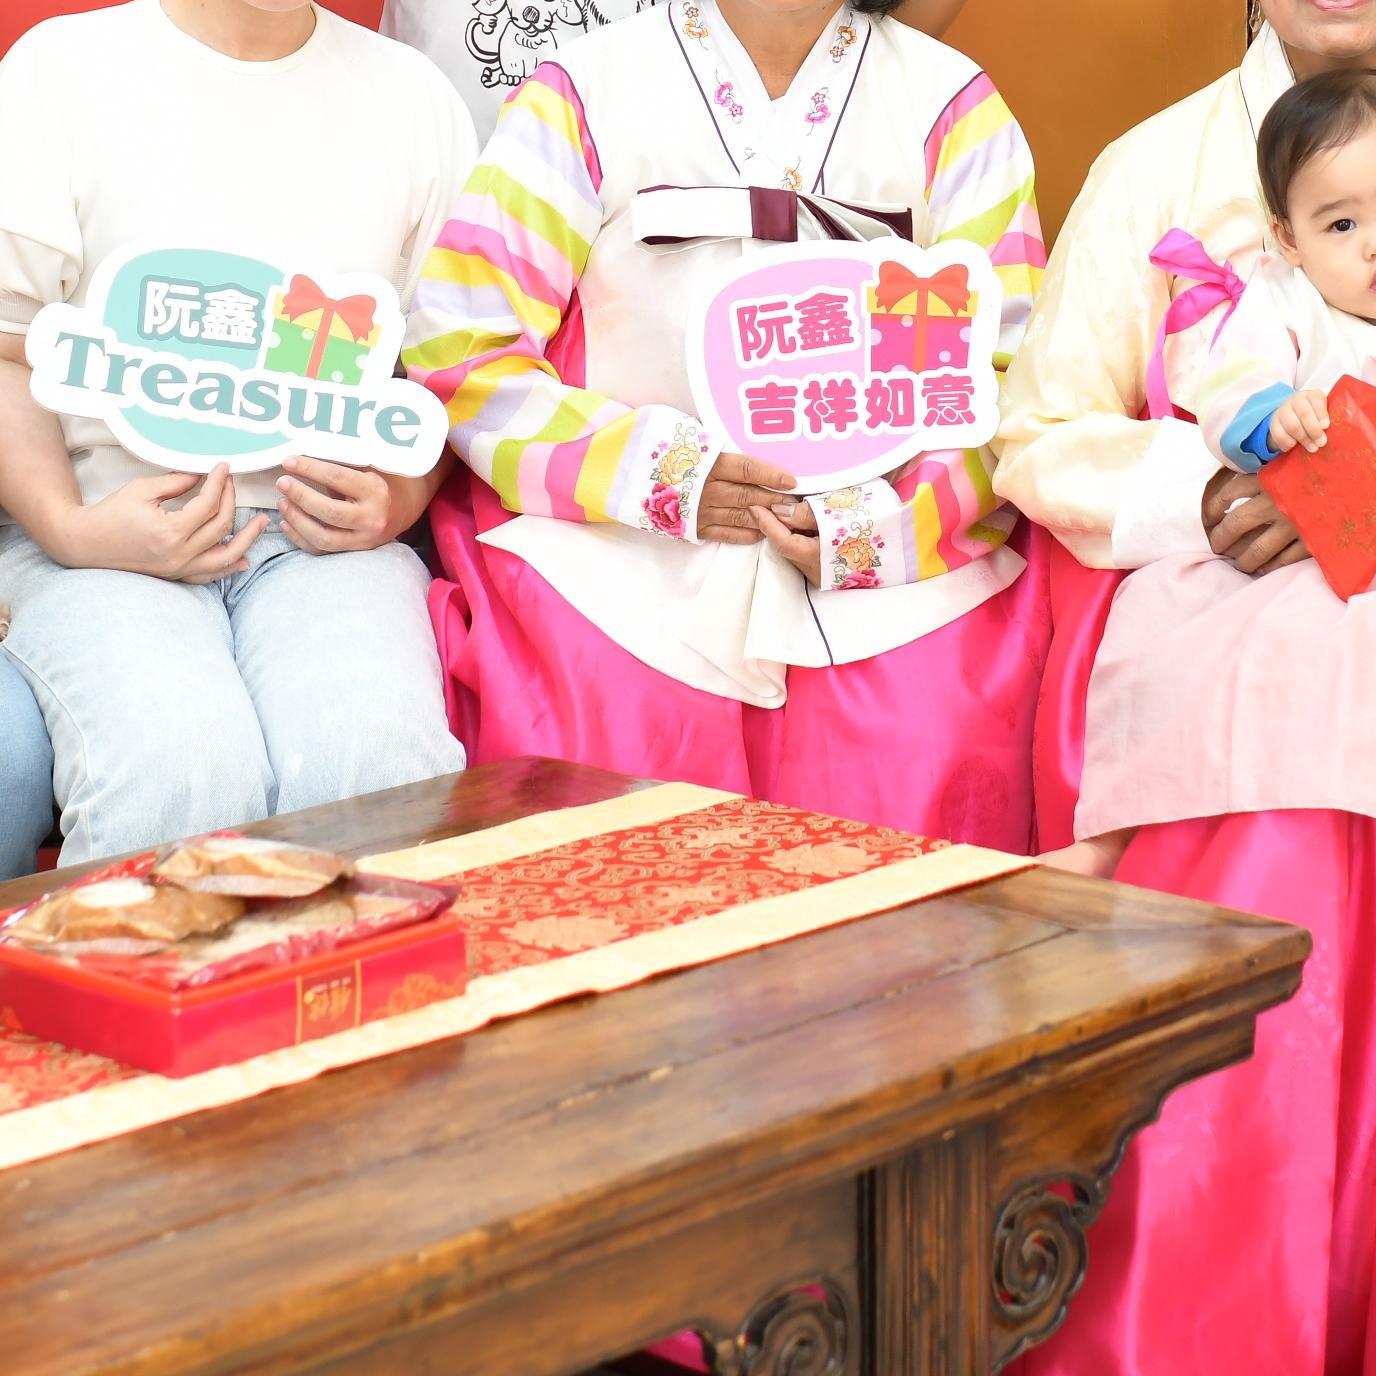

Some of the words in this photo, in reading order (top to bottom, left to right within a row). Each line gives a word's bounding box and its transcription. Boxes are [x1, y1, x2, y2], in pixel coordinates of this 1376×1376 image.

[143, 279, 259, 346] 阮鑫
[736, 292, 855, 362] 阮鑫
[54, 331, 423, 449] Treasure
[744, 373, 977, 435] 吉祥如意
